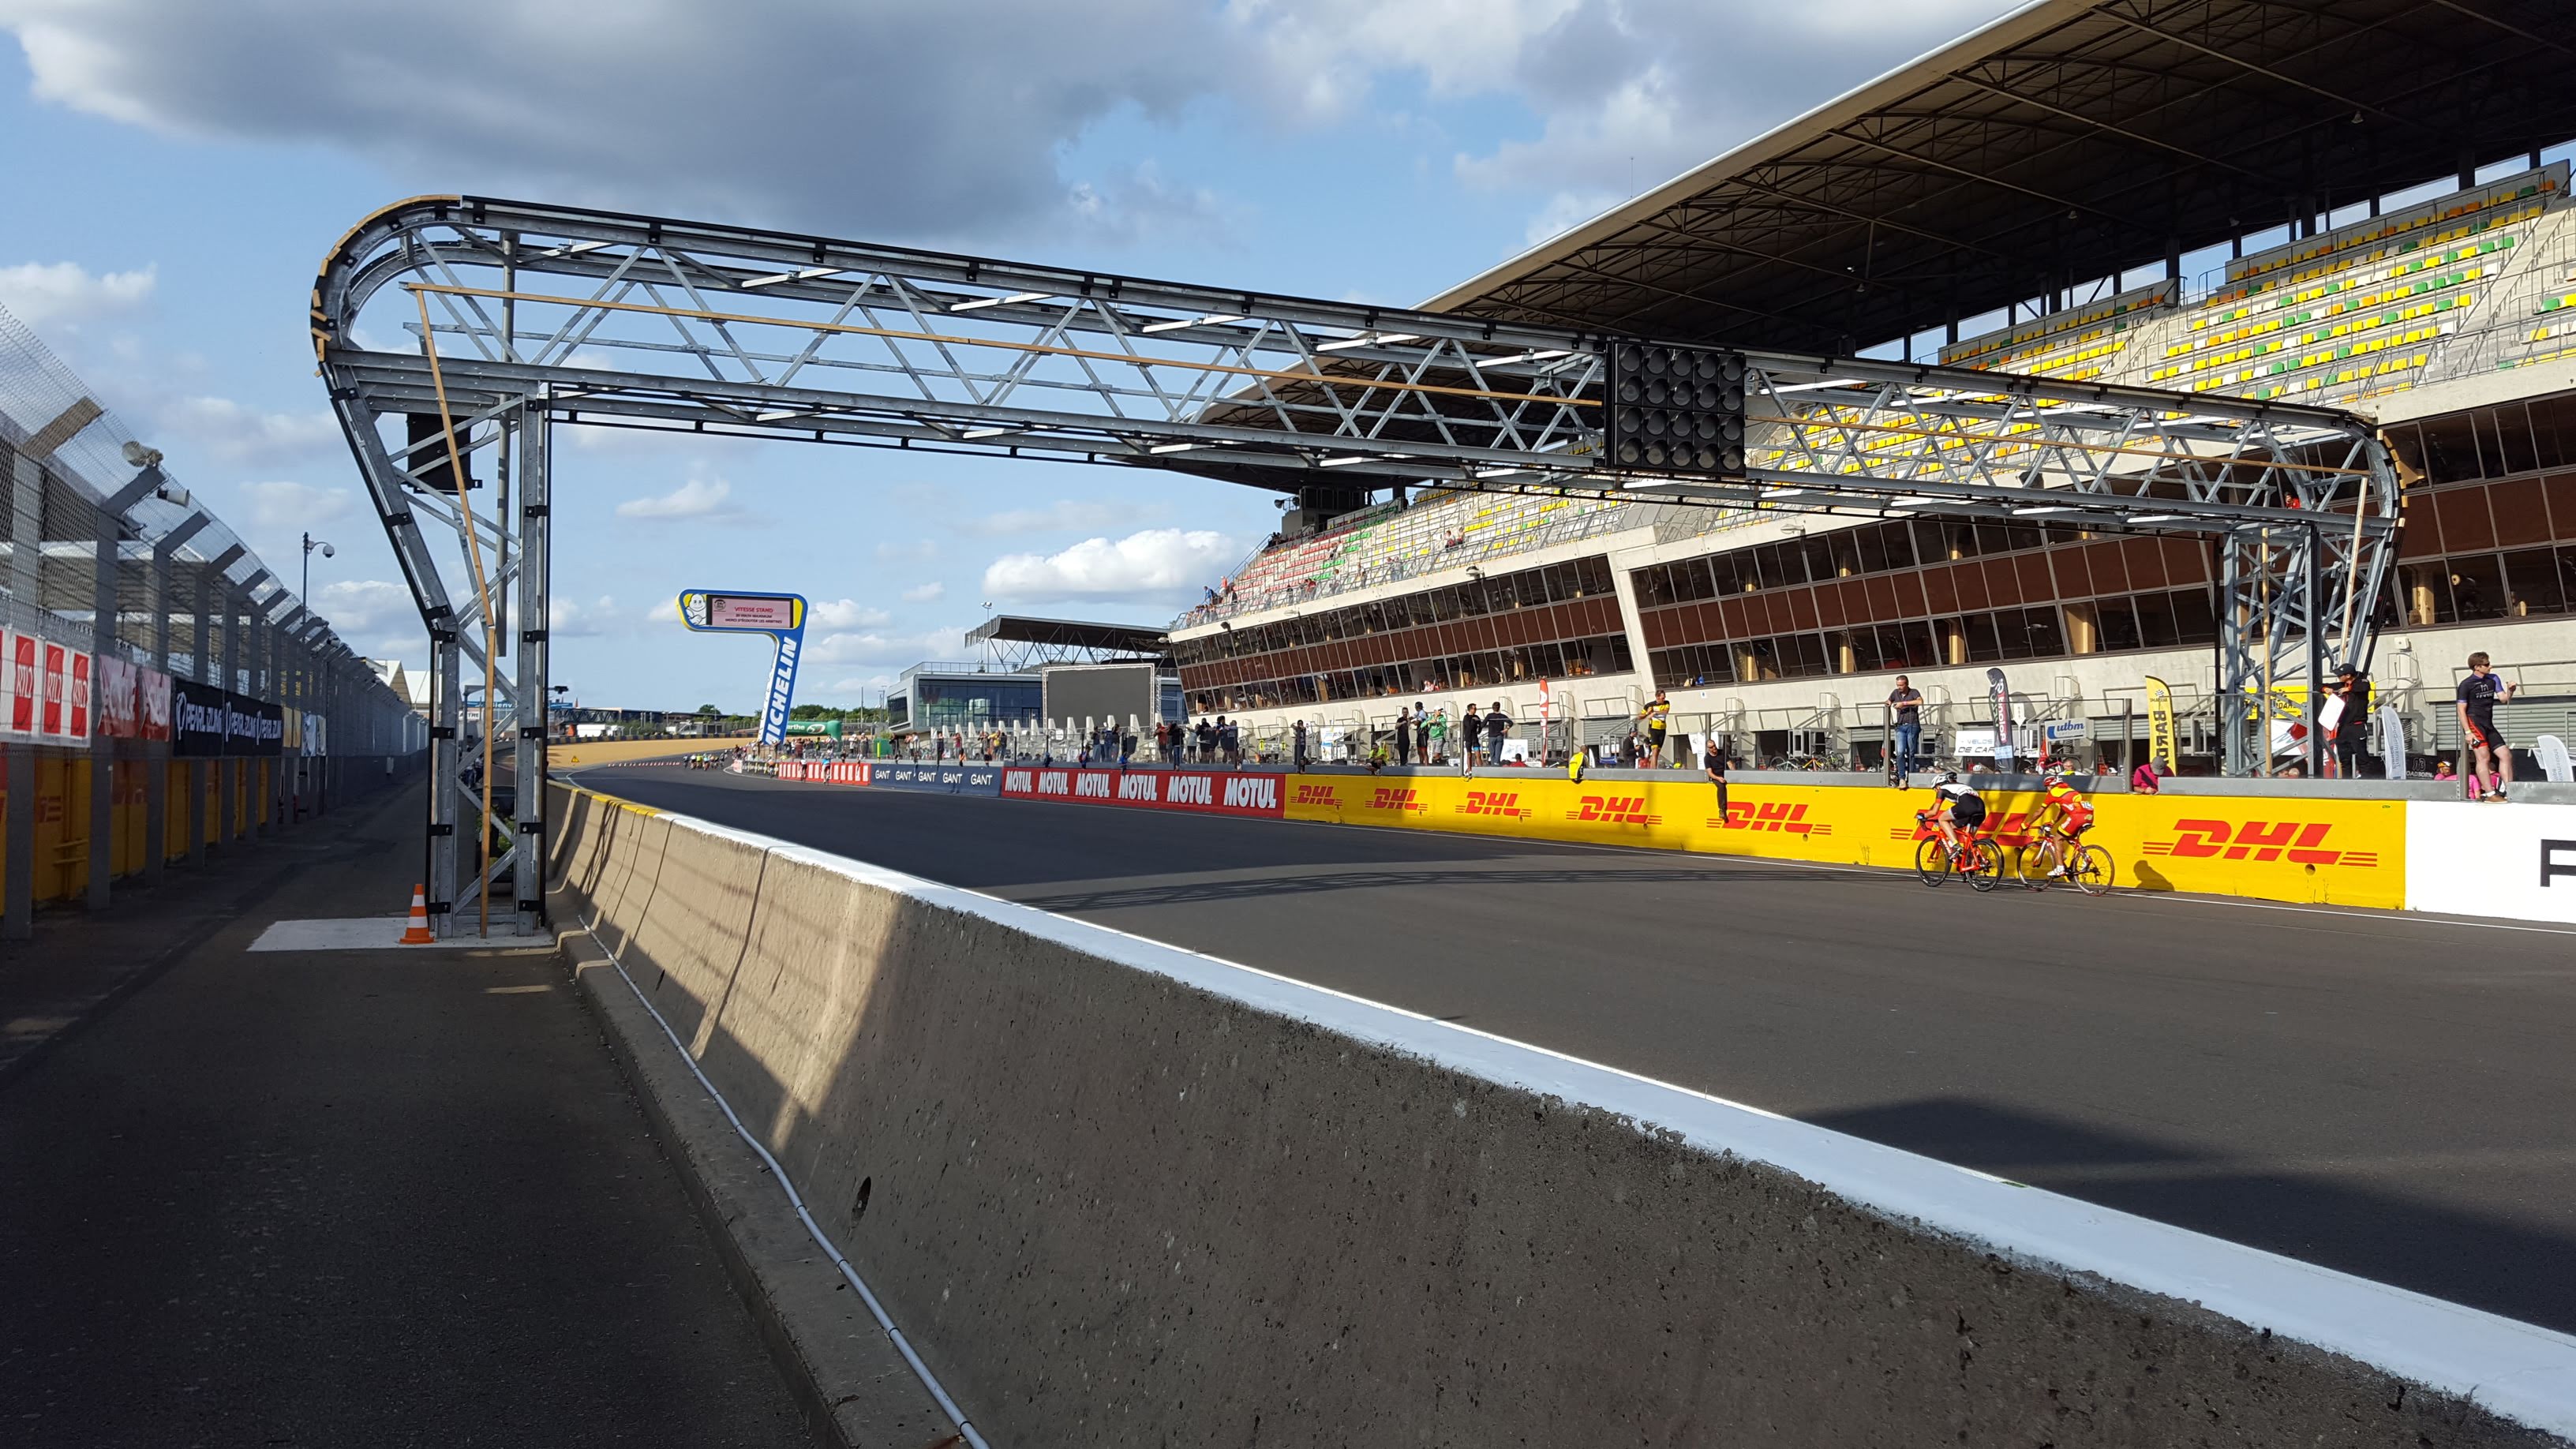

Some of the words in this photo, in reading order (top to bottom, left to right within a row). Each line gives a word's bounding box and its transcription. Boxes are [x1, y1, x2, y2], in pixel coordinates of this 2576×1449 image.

[765, 636, 797, 745] MICHELIN
[2057, 720, 2084, 732] utbm
[875, 769, 890, 780] GANT
[896, 770, 912, 781] GANT
[918, 771, 936, 782] GANT
[943, 773, 962, 784] GANT
[971, 773, 993, 785] GANT
[1005, 770, 1032, 792] MOTUL
[1038, 771, 1068, 795] MOTUL
[1075, 773, 1110, 798] MOTUL
[1118, 774, 1157, 801] MOTUL
[1166, 775, 1212, 804] MOTUL
[1223, 777, 1276, 809] MOTUL
[1297, 784, 1335, 806] DHL
[1372, 788, 1419, 811] DHL
[1465, 791, 1521, 817] DHL
[1578, 796, 1647, 824] DHL
[1727, 801, 1814, 834] DHL
[2170, 818, 2341, 865] DHL
